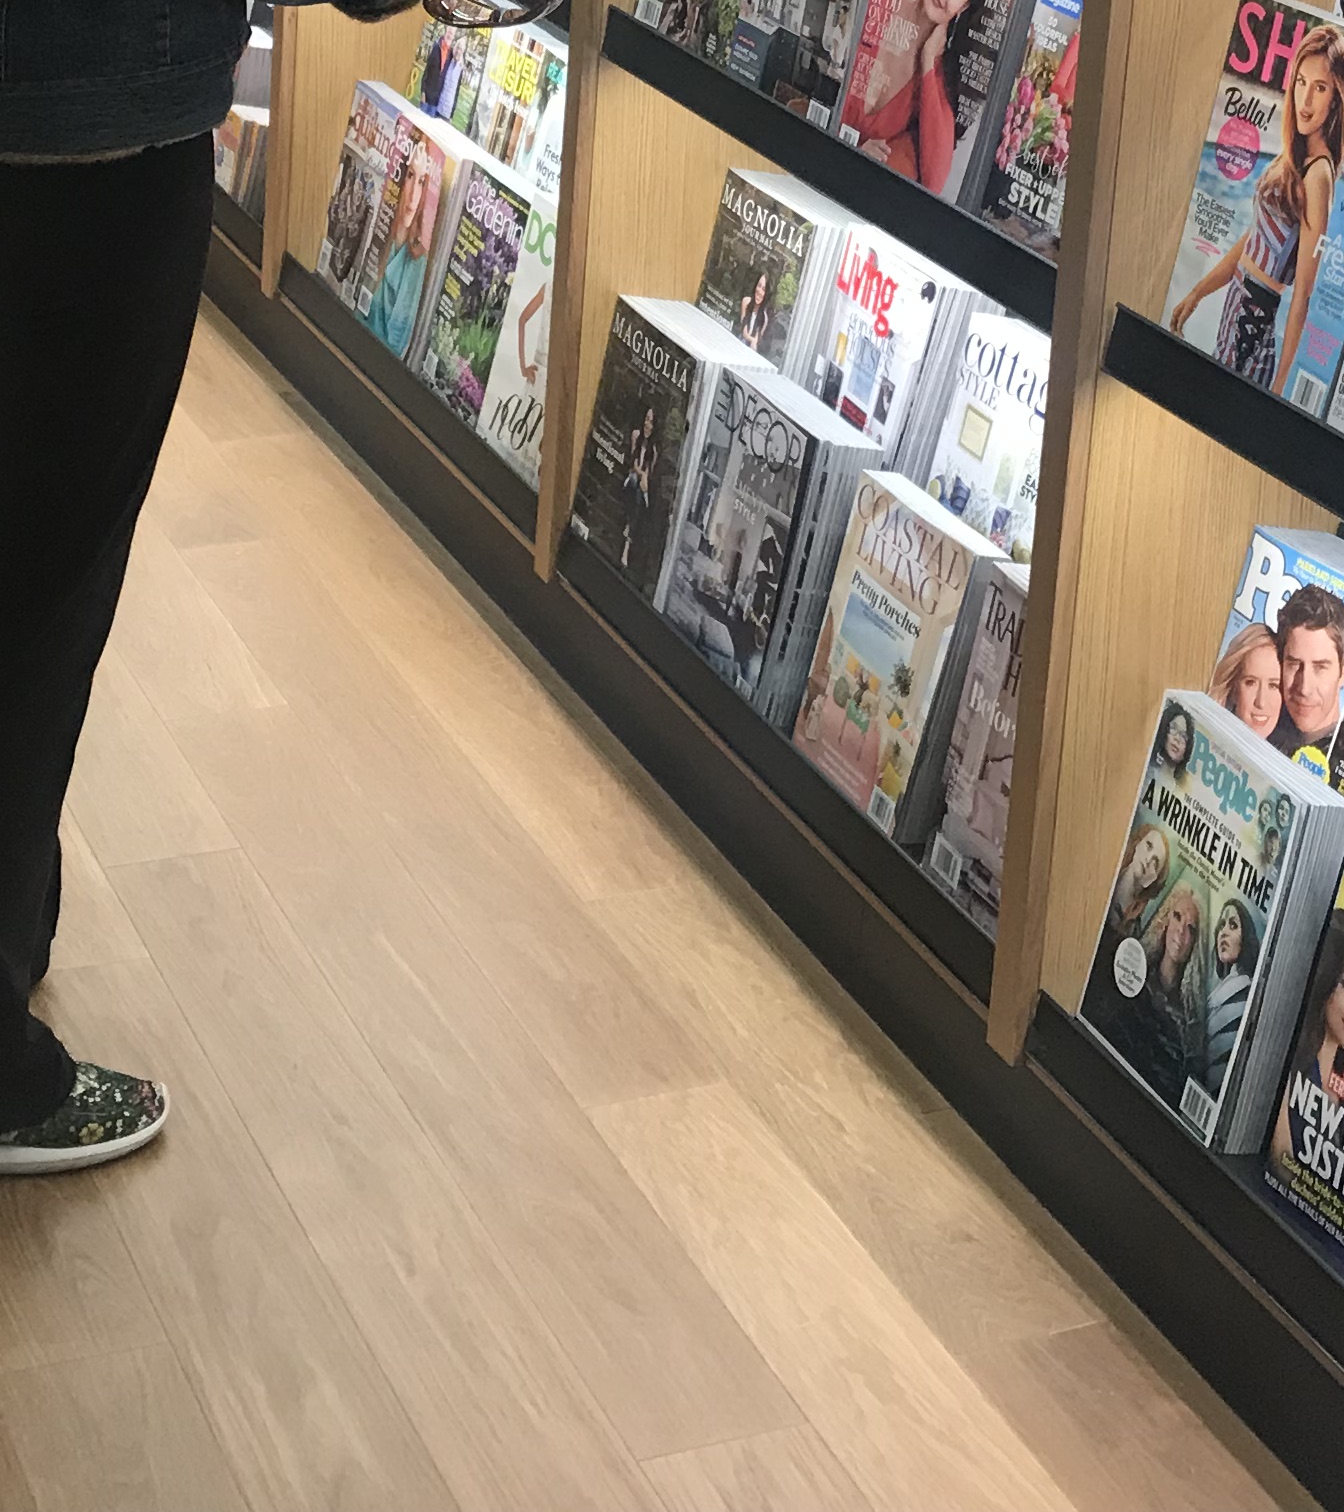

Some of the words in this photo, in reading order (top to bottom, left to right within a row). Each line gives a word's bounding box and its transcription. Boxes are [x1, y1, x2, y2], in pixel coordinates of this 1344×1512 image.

[1223, 86, 1278, 131] Bella!
[721, 183, 805, 258] MAGNOLIA
[741, 223, 774, 250] JOURNAL
[836, 230, 899, 338] Living
[611, 311, 688, 393] MAGNOLIA
[856, 482, 963, 590] COASTAL
[1157, 786, 1217, 869] WRINKLE
[1236, 855, 1275, 915] TIME
